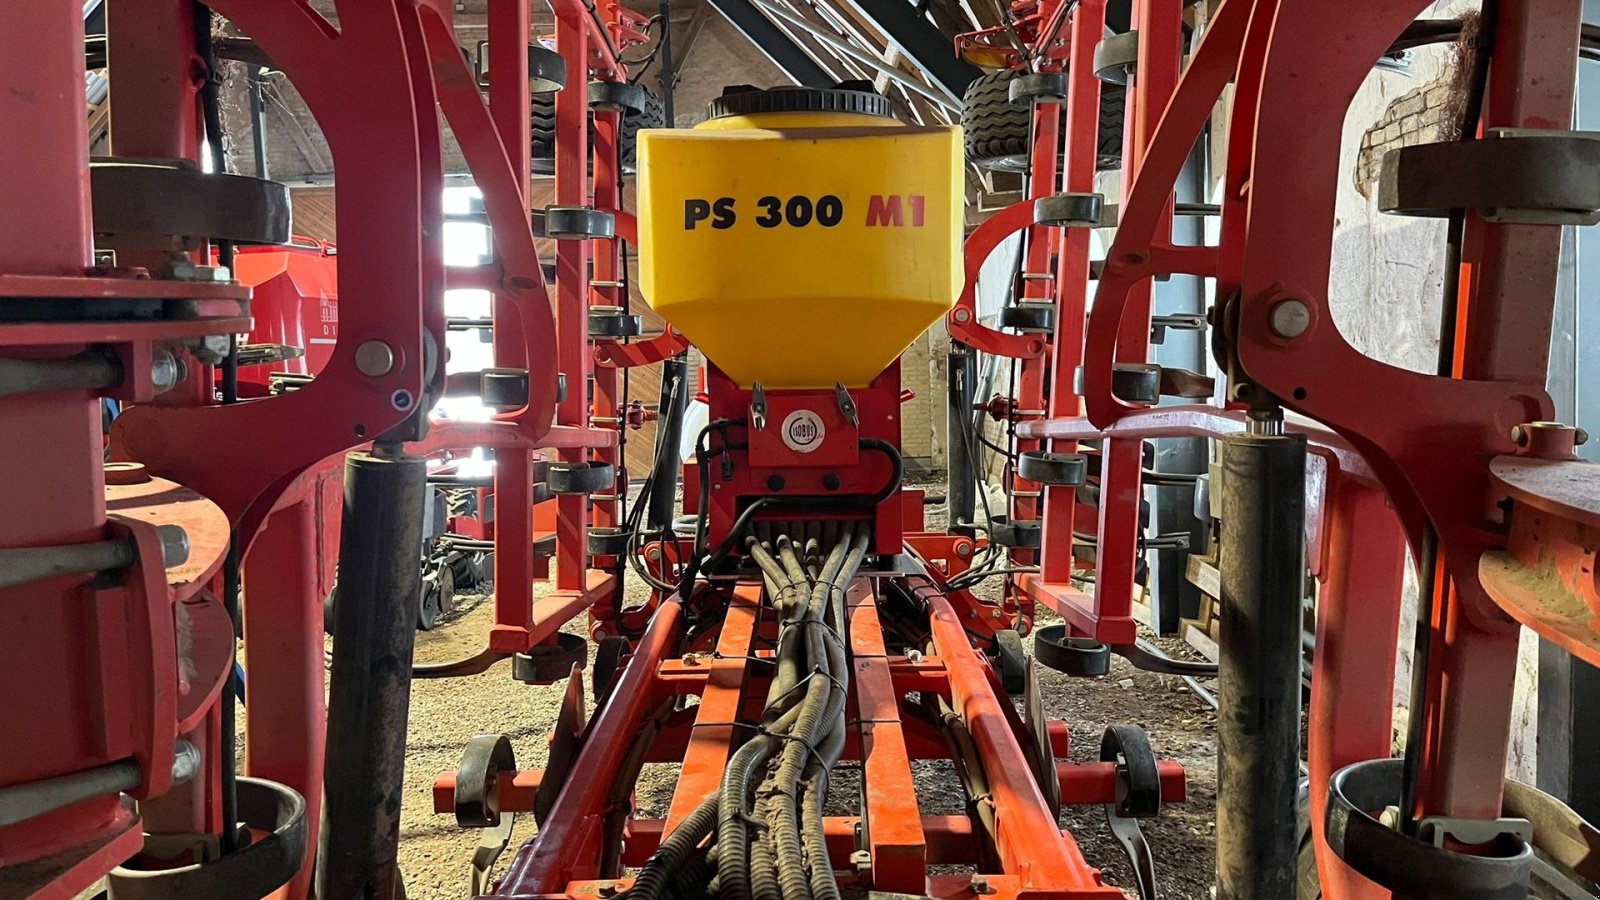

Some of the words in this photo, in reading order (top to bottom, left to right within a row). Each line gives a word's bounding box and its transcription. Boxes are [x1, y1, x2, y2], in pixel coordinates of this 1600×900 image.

[684, 197, 737, 230] PS
[755, 195, 844, 228] 300
[865, 195, 926, 227] M1
[792, 424, 813, 438] ISOBUS
